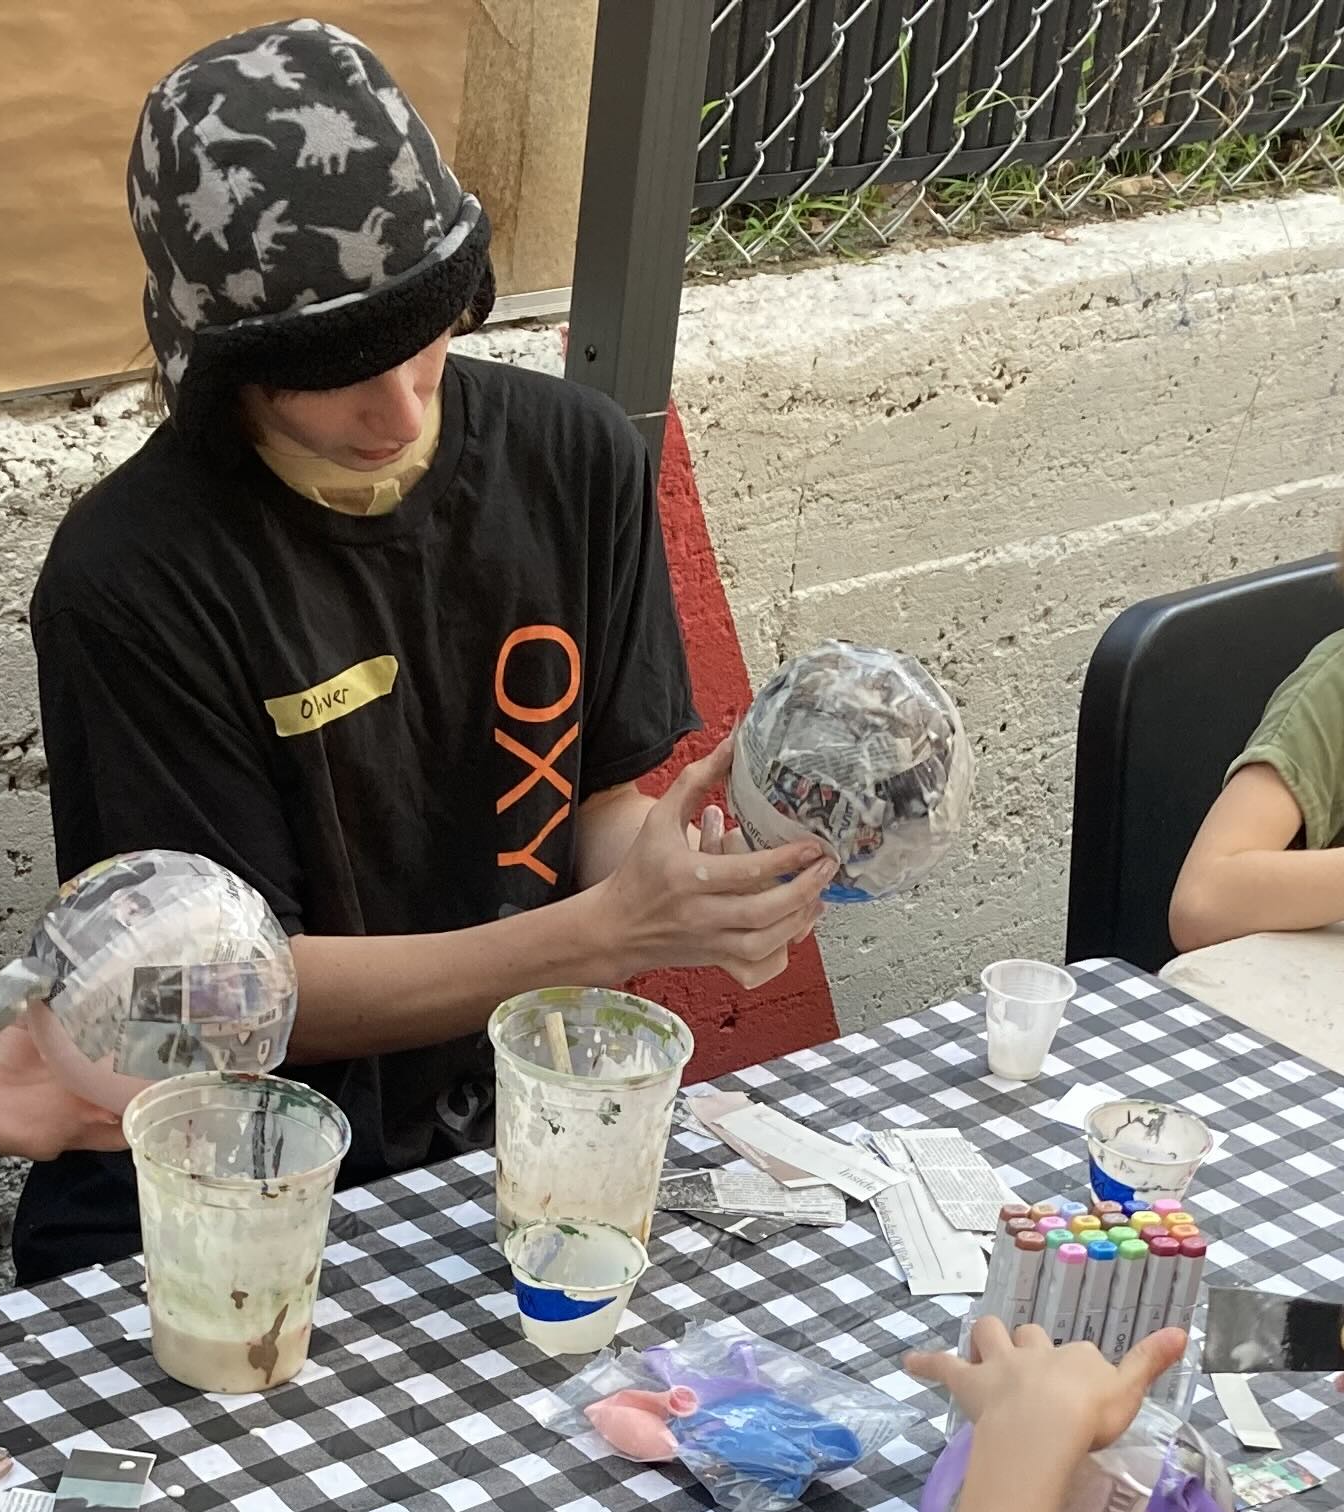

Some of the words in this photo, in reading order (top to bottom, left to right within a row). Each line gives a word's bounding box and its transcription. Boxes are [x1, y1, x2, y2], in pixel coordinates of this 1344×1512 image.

[300, 687, 350, 720] Oliver
[494, 624, 581, 886] OXY
[839, 1167, 878, 1193] Inside
